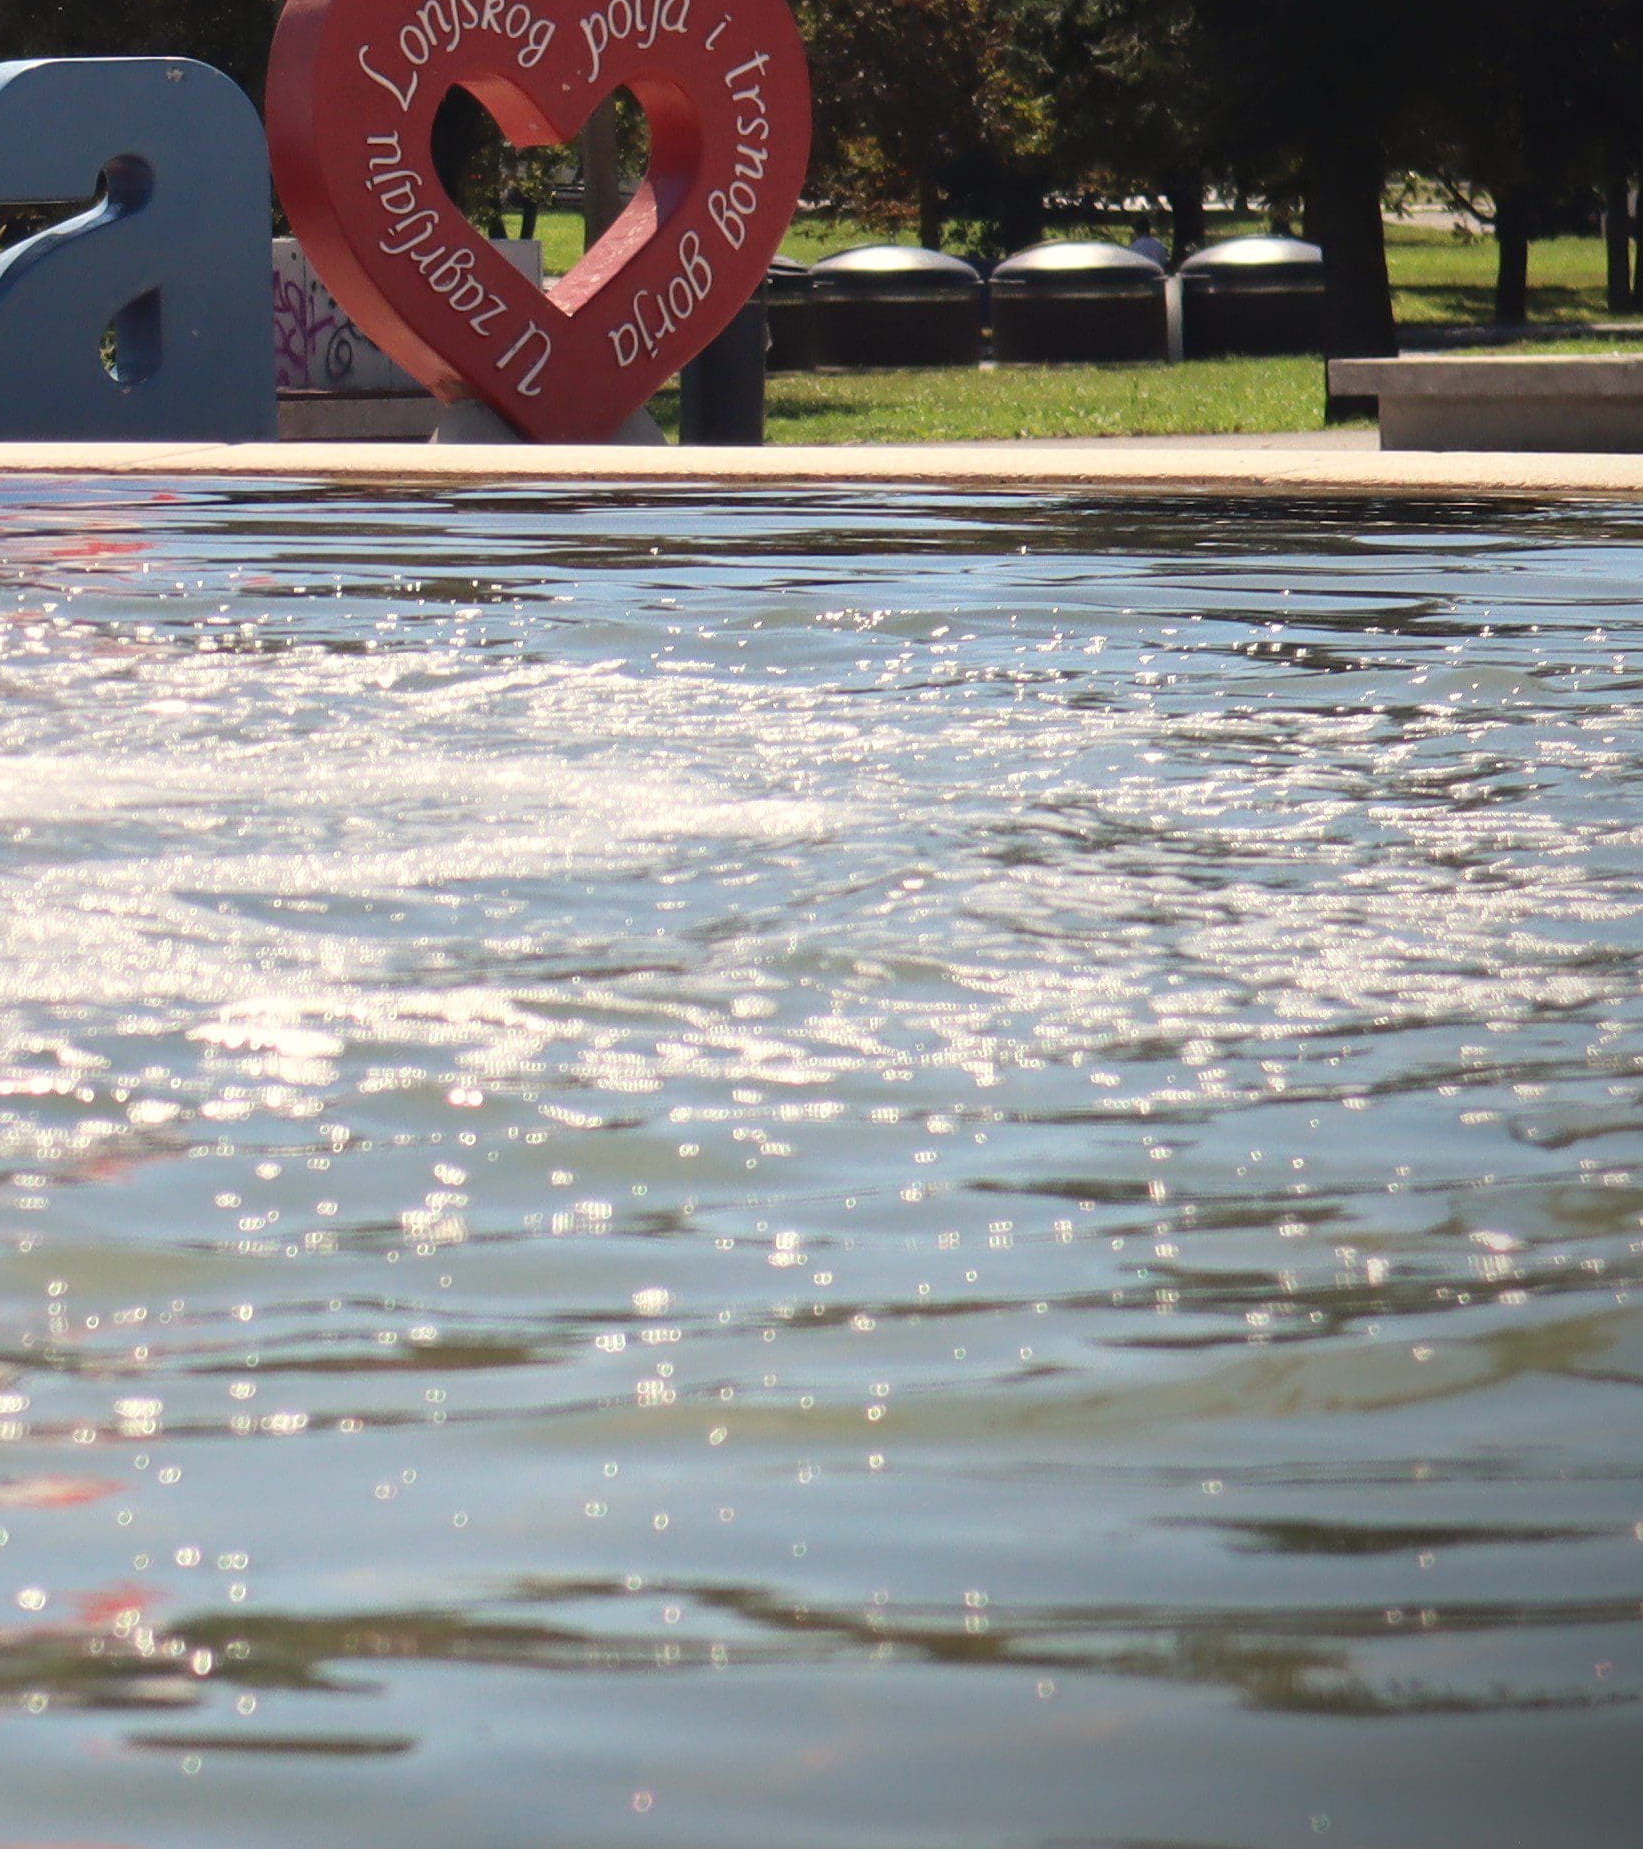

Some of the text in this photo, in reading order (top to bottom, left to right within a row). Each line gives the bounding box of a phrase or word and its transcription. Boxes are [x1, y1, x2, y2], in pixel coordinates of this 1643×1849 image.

[704, 13, 733, 51] i
[707, 50, 771, 251] trsnog
[365, 129, 509, 337] zagrljaju
[607, 229, 713, 368] gorja
[494, 319, 552, 397] U
